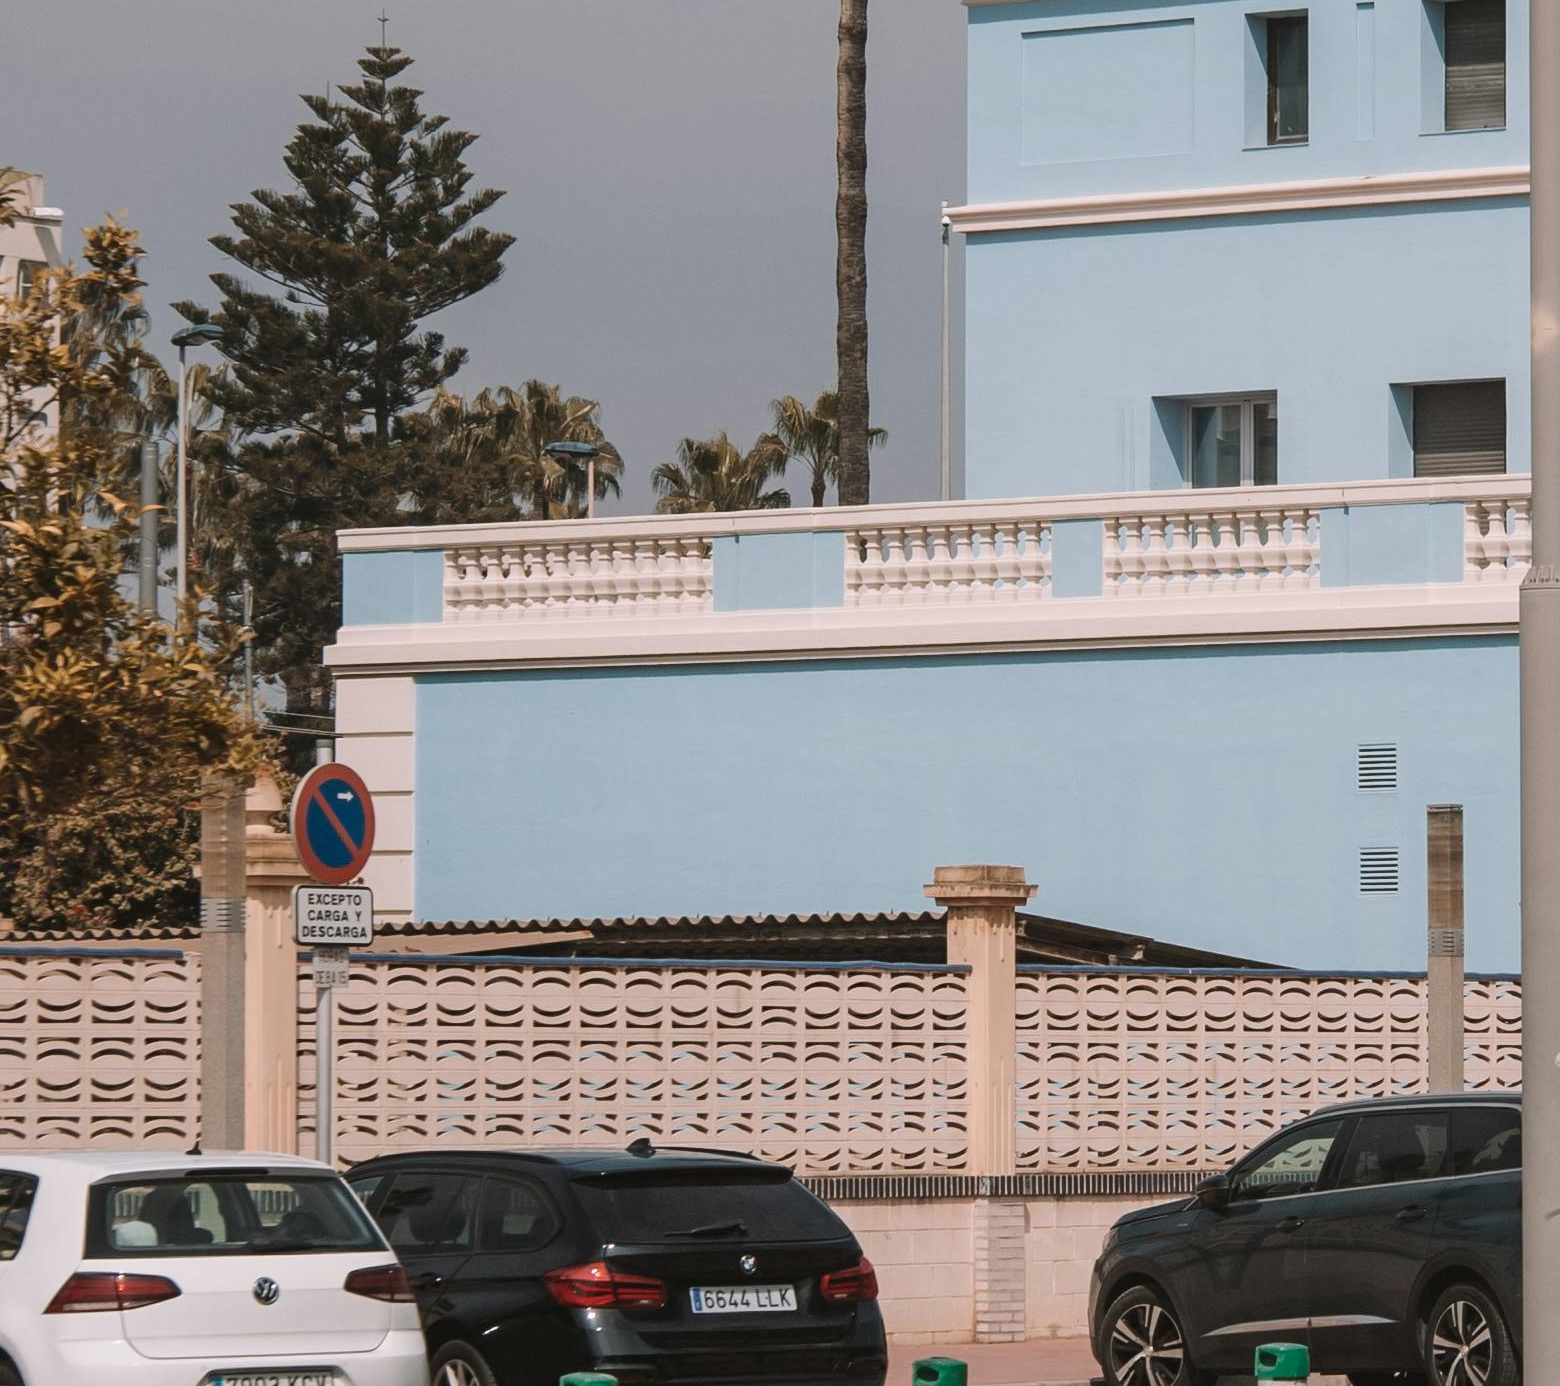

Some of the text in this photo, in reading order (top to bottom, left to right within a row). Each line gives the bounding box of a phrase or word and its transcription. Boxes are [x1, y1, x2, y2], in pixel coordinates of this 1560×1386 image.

[307, 893, 362, 906] EXCEPTO
[307, 909, 362, 922] CARGA Y
[301, 925, 368, 938] DESCARGA
[703, 1288, 792, 1309] 6644 LLK
